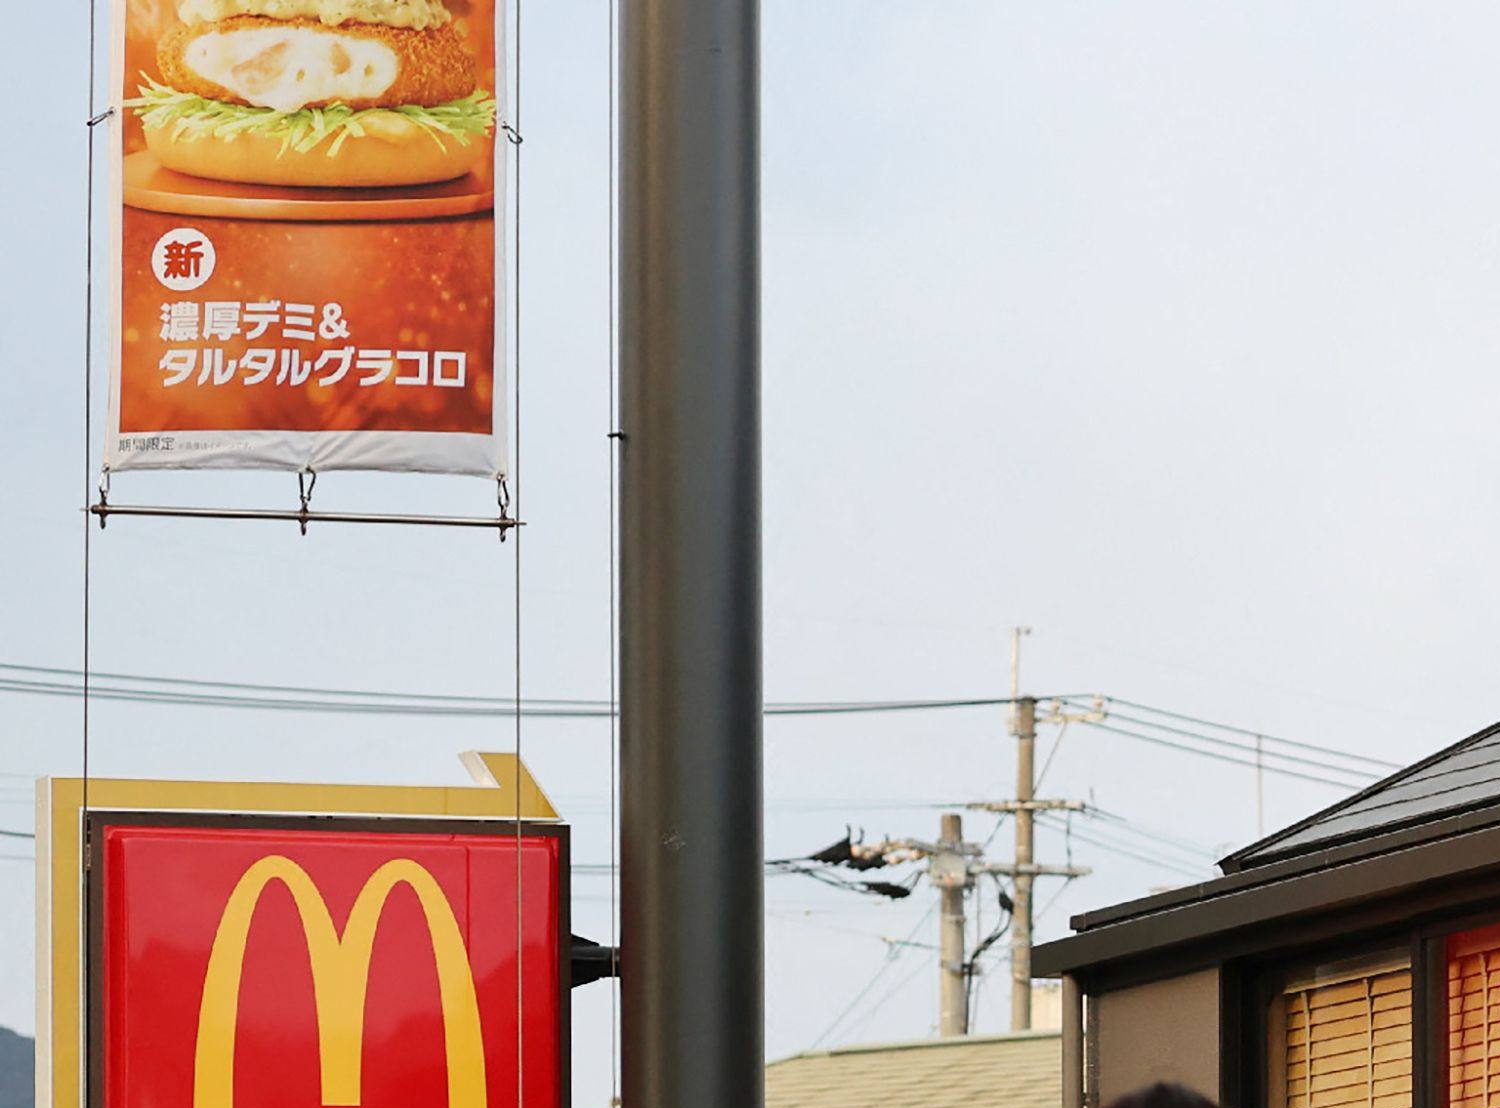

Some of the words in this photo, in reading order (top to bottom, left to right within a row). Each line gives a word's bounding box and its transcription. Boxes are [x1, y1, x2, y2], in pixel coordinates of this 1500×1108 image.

[163, 240, 205, 279] 新
[158, 300, 351, 342] 濃厚デミ&
[158, 345, 468, 389] タルタルグラコロ
